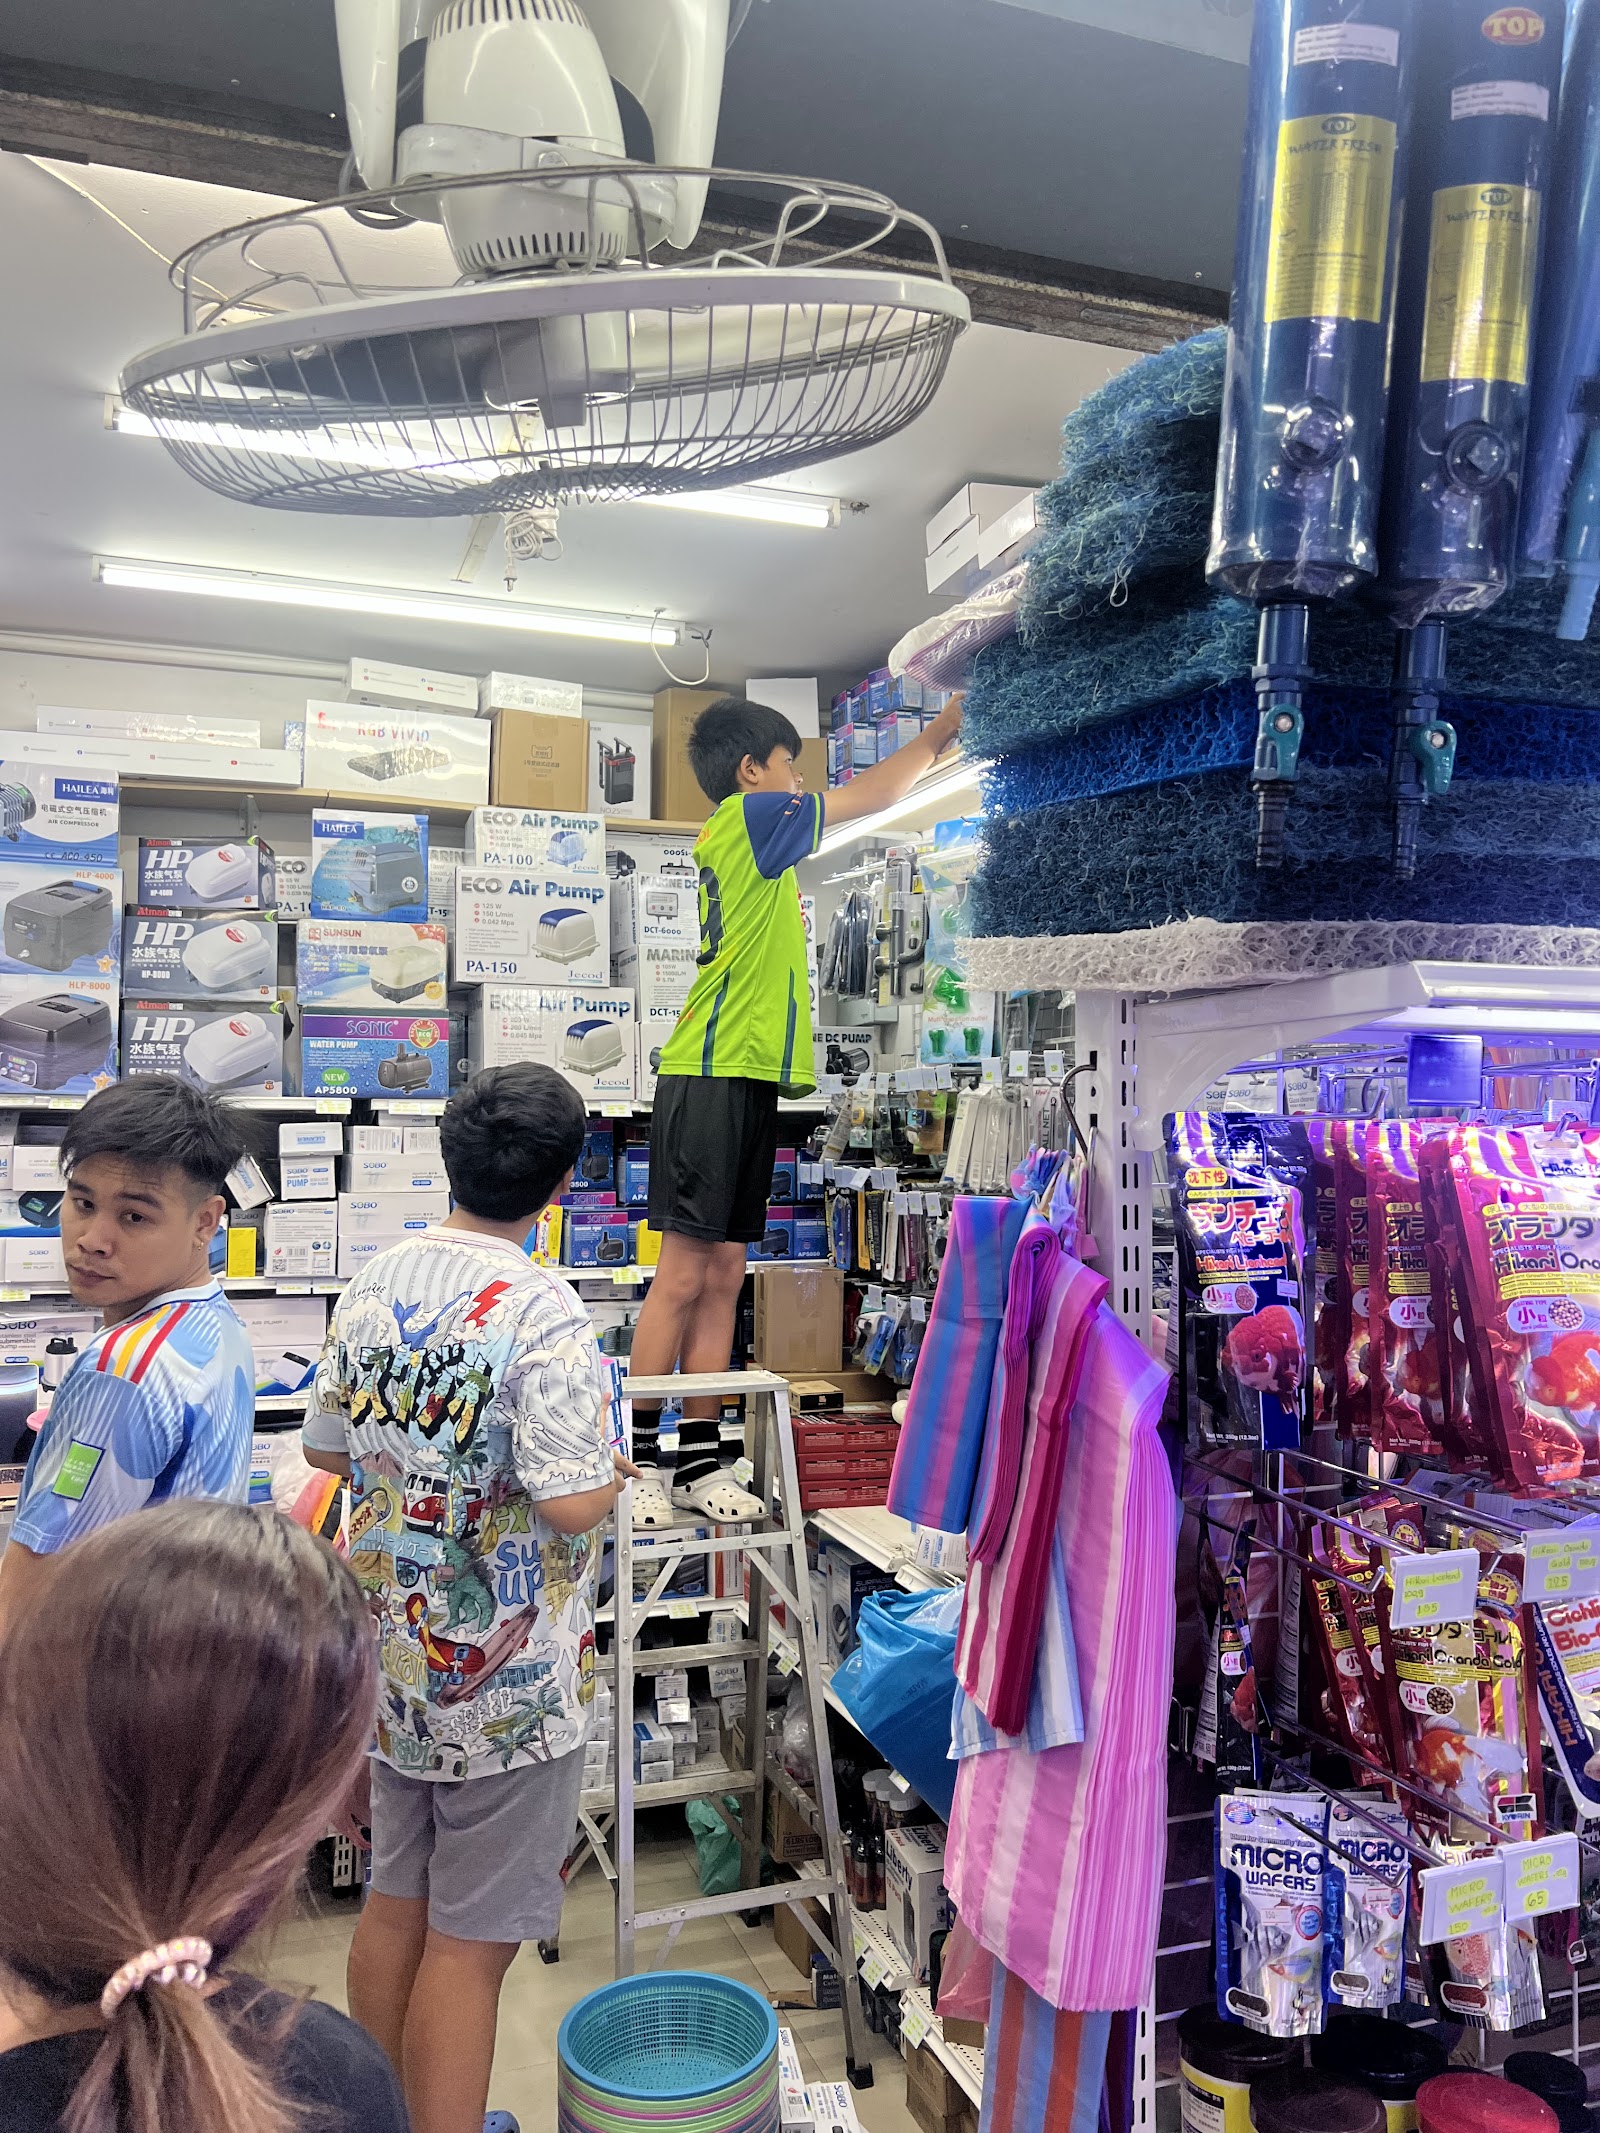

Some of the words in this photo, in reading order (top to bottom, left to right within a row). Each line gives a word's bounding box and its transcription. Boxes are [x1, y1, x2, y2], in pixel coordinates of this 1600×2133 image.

[1487, 17, 1543, 37] TOP
[358, 721, 385, 738] RGB
[62, 783, 99, 794] HAILEA
[60, 819, 100, 827] COMPRESSOR
[322, 823, 357, 834] HAILEA
[483, 811, 517, 826] ECO
[521, 813, 546, 827] Air
[551, 815, 600, 833] Pump
[146, 850, 194, 869] HP
[484, 852, 533, 865] PA-100
[76, 871, 115, 880] HLP-4000
[641, 876, 683, 889] MARINE
[461, 876, 504, 893] ECO
[508, 879, 540, 896] Air
[546, 881, 605, 904] Pump
[136, 906, 169, 916] Atman
[132, 922, 195, 945] HP
[323, 929, 362, 938] SUNSUN
[644, 926, 682, 935] DCT-6000
[131, 947, 181, 959] 水族气泵
[466, 960, 517, 974] PA-150
[568, 970, 603, 979] Jecod
[69, 981, 110, 990] HLP-8000
[136, 1001, 169, 1010] Atman
[573, 996, 631, 1017] Pump
[130, 1016, 196, 1041] HP
[346, 1020, 393, 1036] SONIC
[309, 1040, 335, 1048] WATER
[336, 1041, 358, 1049] PUMP
[825, 1033, 839, 1043] DC
[841, 1034, 872, 1043] PUMP
[129, 1043, 181, 1055] 水族气泵
[324, 1073, 346, 1082] NEW
[595, 1078, 629, 1086] Jecod
[315, 1086, 358, 1095] AP5800
[1227, 1089, 1250, 1098] SOBO
[1288, 1082, 1307, 1091] SOBO
[287, 1178, 308, 1187] PUMP
[1188, 1170, 1225, 1184] 沈下性
[350, 1201, 378, 1209] SOBO
[573, 1195, 601, 1205] SONIC
[586, 1214, 611, 1224] SONIC
[1196, 1254, 1235, 1272] Hikari
[1235, 1252, 1288, 1270] Lionhead
[1494, 1252, 1556, 1275] Hikari
[1503, 1288, 1541, 1298] Outstanding
[434, 1497, 447, 1508] 28
[923, 1538, 931, 1560] SOBO
[932, 1550, 941, 1568] PUMP
[855, 1577, 893, 1587] SURPASS
[853, 1586, 867, 1594] AIR
[868, 1584, 894, 1592] PUMP
[1434, 1649, 1491, 1667] Oranda
[1492, 1648, 1523, 1668] Gold
[715, 1667, 739, 1676] SOBO
[1538, 1669, 1578, 1747] HIKARI
[1573, 1721, 1586, 1741] GREAT
[910, 1827, 942, 1855] Liberty
[1230, 1832, 1248, 1841] Ideal
[1249, 1834, 1257, 1842] for
[1258, 1836, 1295, 1847] Community
[1296, 1840, 1315, 1848] Tanks
[1231, 1843, 1324, 1876] MICRO
[1338, 1838, 1406, 1863] MICRO
[1522, 1855, 1552, 1871] MICRO
[886, 1840, 914, 1892] Liberty
[1245, 1870, 1317, 1892] WAFERS
[1450, 1879, 1484, 1898] MICRO
[1527, 1890, 1544, 1907] 65
[1449, 1922, 1468, 1934] 150
[779, 2029, 791, 2047] SOBO
[834, 2084, 848, 2108] SOBO
